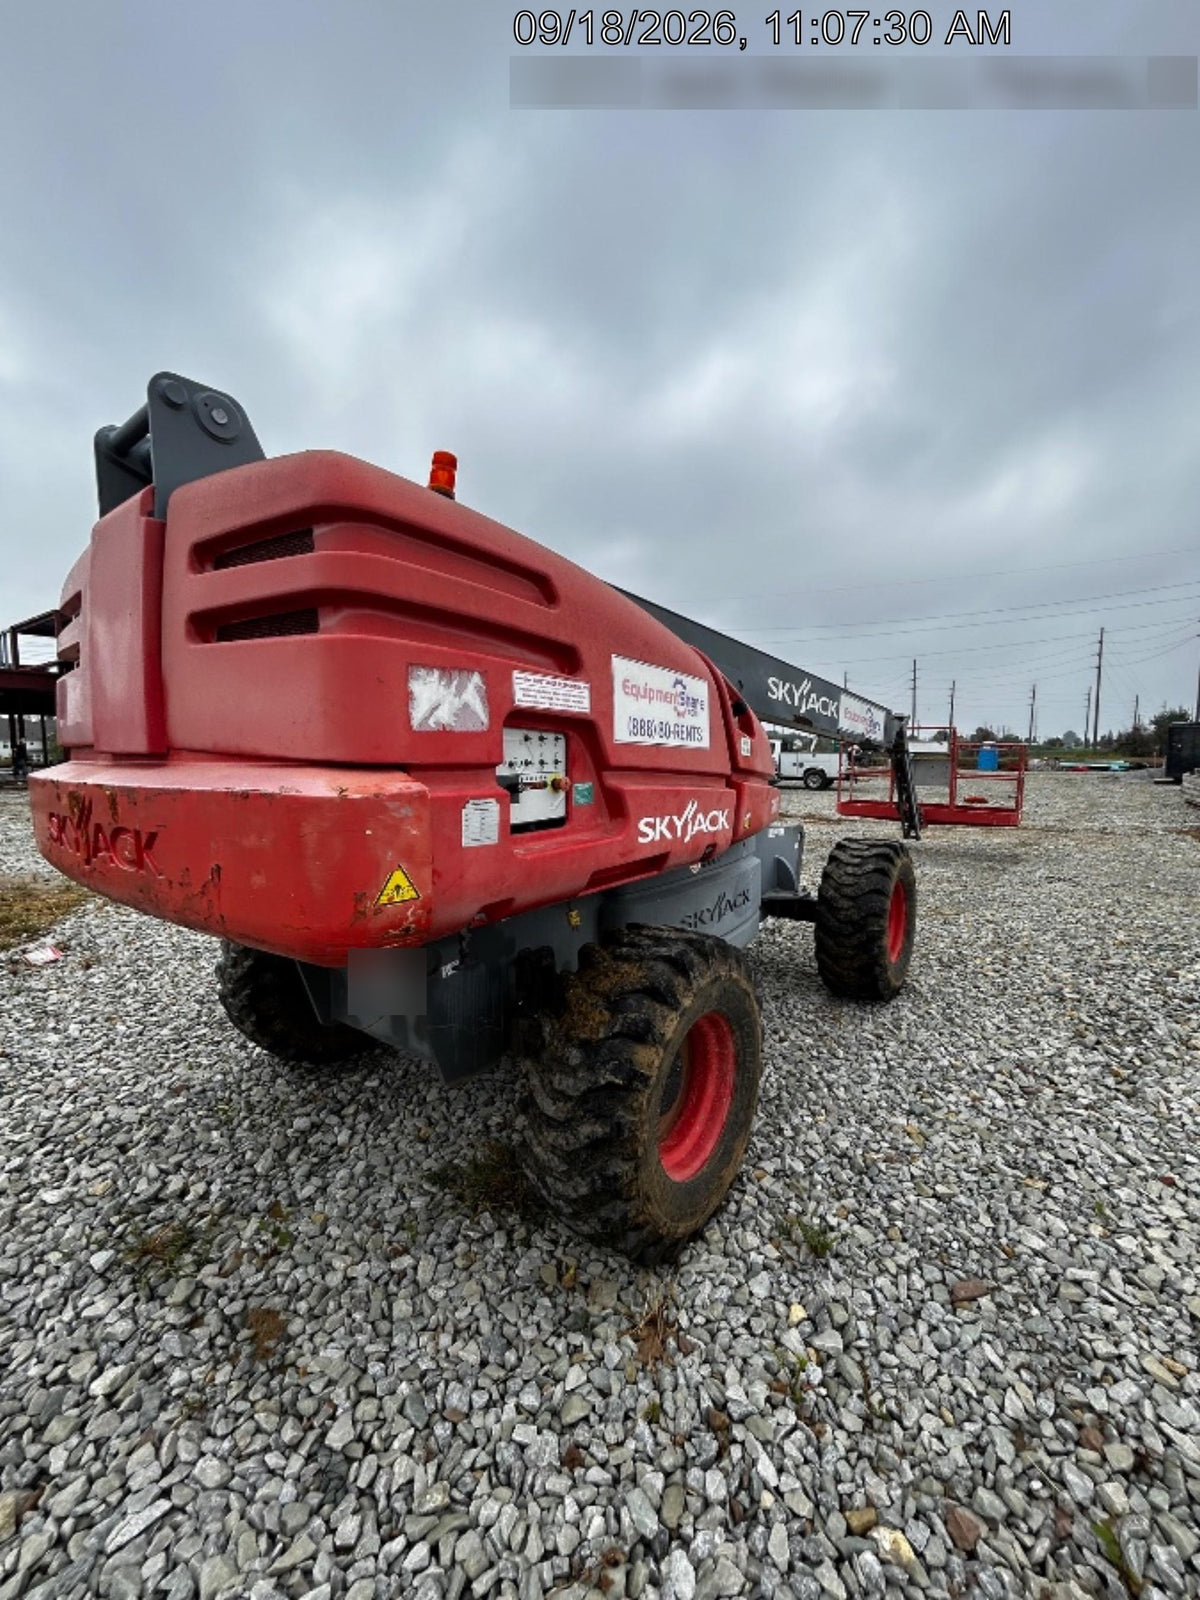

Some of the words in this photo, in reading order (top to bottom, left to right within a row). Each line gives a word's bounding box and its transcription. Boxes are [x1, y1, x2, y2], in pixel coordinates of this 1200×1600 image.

[768, 677, 838, 719] SKYJACK
[48, 794, 165, 878] SKYJACK
[637, 799, 730, 843] SKYJACK
[680, 889, 751, 928] SKYJACK
